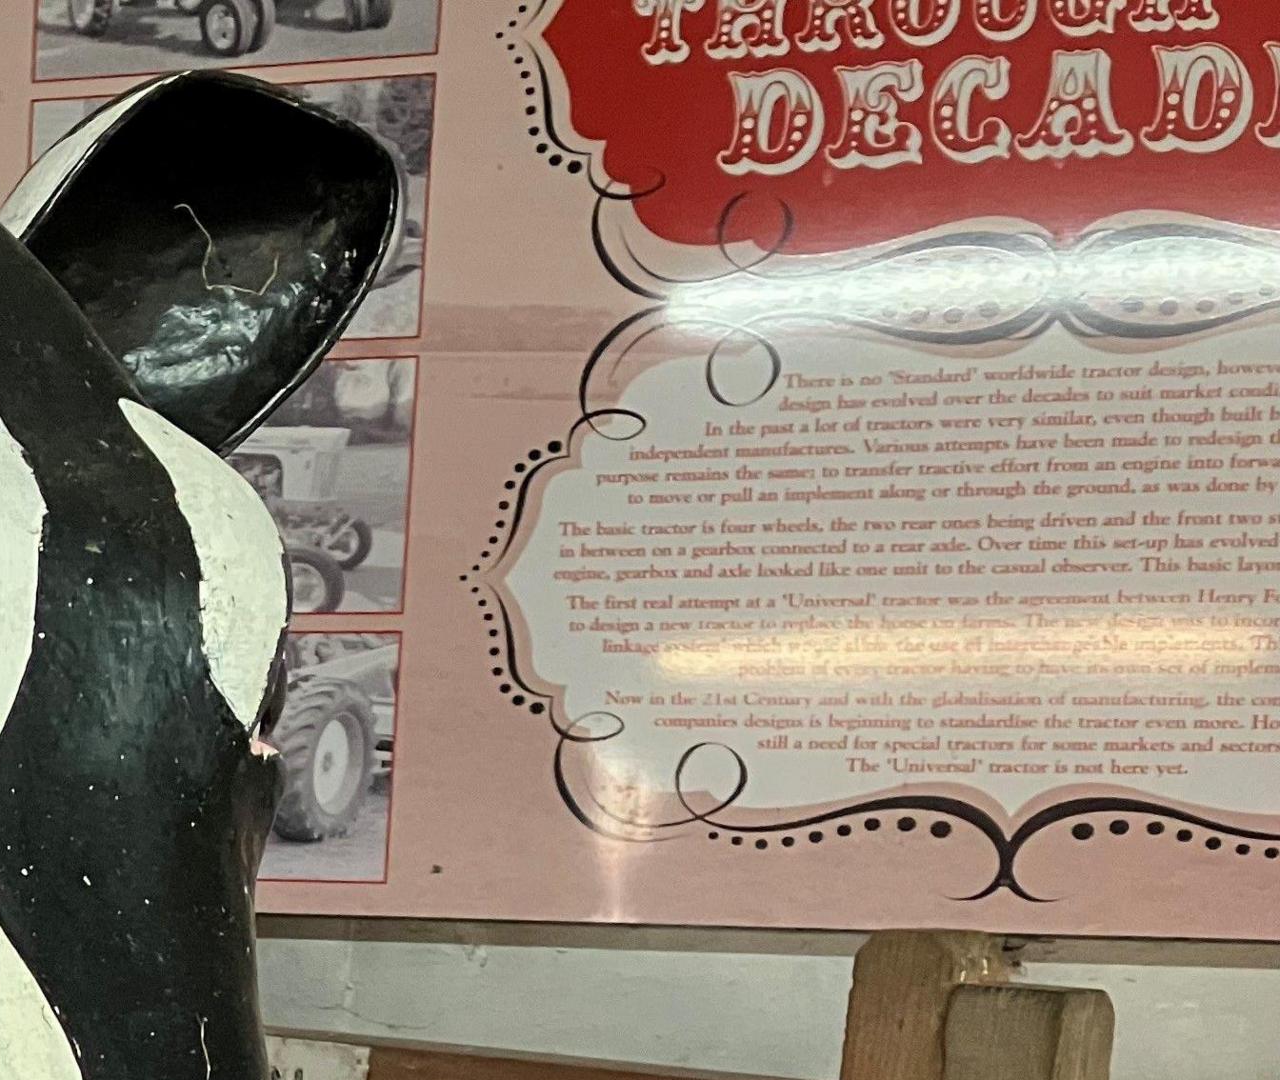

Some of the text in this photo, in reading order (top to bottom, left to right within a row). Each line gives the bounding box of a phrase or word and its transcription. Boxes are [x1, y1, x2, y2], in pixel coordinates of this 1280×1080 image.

[716, 42, 1280, 176] DECAD
[783, 373, 834, 388] There
[860, 376, 881, 386] no
[983, 366, 1074, 383] worldwide
[1081, 367, 1142, 380] tractor
[779, 384, 1221, 415] design has evolved over the decades suit market
[705, 422, 722, 436] In
[728, 421, 754, 435] the
[760, 422, 794, 438] past
[798, 424, 808, 433] a
[814, 418, 837, 433] lot
[843, 418, 860, 432] of
[866, 419, 932, 431] tractors
[940, 419, 980, 429] were
[988, 417, 1025, 432] very
[1100, 414, 1144, 425] even
[1152, 408, 1214, 427] though
[1220, 406, 1262, 421] built
[629, 444, 728, 464] independent
[864, 439, 928, 454] Various
[934, 440, 1009, 456] attempts
[1015, 435, 1056, 450] have
[1063, 434, 1104, 449] been
[1111, 433, 1157, 448] made
[1164, 435, 1181, 446] to
[1188, 430, 1262, 450] redesign
[596, 471, 658, 485] purpose
[664, 466, 728, 480] remains
[735, 464, 761, 479] the
[822, 465, 838, 477] to
[843, 461, 912, 476] transfer
[918, 461, 984, 475] tractive
[990, 458, 1039, 473] effort
[1046, 457, 1088, 472] from
[1094, 461, 1115, 471] an
[1121, 457, 1180, 474] engine
[1186, 456, 1223, 469] into
[628, 477, 1278, 506] to move or pull an implement along or through the as was done by
[559, 511, 1262, 535] The basic tractor is four the two rear ones being driven and the front two
[559, 544, 574, 557] in
[579, 542, 645, 557] between
[652, 546, 671, 556] on
[691, 540, 754, 559] gearbox
[761, 539, 846, 554] connected
[890, 543, 925, 553] rear
[976, 537, 1021, 551] Over
[1028, 538, 1066, 551] time
[1073, 536, 1105, 550] this
[1113, 538, 1167, 553] set-up
[1173, 534, 1203, 549] has
[1209, 533, 1278, 548] evolved
[614, 564, 678, 582] gearbox
[682, 563, 712, 578] and
[718, 563, 750, 577] axle
[756, 562, 812, 577] looked
[818, 562, 849, 576] like
[856, 566, 886, 576] one
[892, 562, 927, 575] unit
[958, 560, 984, 574] the
[991, 559, 1046, 574] casual
[1140, 558, 1180, 572] This
[1186, 557, 1230, 572] basic
[567, 589, 1255, 612] The first real attempt tractor was the agreement between Henry
[589, 616, 778, 635] design new tractor to
[602, 638, 660, 656] linkage
[604, 690, 641, 705] Now
[670, 691, 696, 705] the
[742, 691, 810, 709] Century
[818, 691, 849, 705] and
[856, 691, 893, 705] with
[899, 691, 925, 705] the
[932, 691, 1041, 709] globalisation
[1046, 691, 1066, 705] of
[1216, 691, 1244, 705] the
[654, 714, 736, 730] companies
[744, 712, 802, 731] designs
[826, 713, 910, 731] beginning
[940, 713, 1036, 728] standardise
[1044, 714, 1072, 728] the
[1078, 717, 1137, 728] tractor
[1145, 719, 1186, 728] even
[757, 735, 1213, 754] still need for special tractors for some markets and
[845, 758, 878, 772] The
[988, 762, 1047, 773] tractor
[1074, 762, 1102, 774] not
[1110, 760, 1148, 774] here
